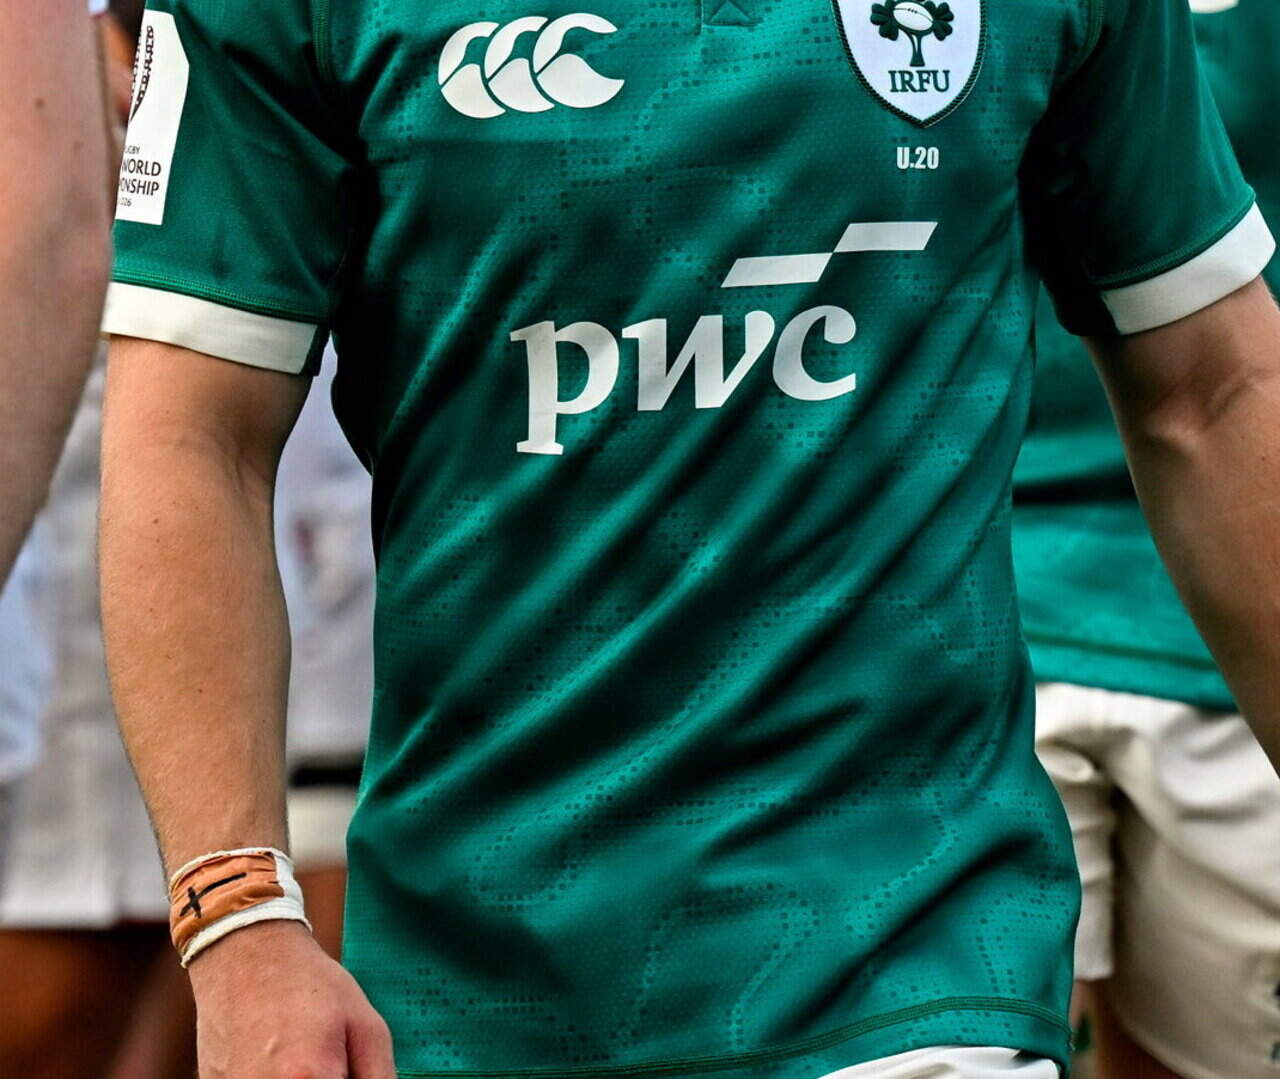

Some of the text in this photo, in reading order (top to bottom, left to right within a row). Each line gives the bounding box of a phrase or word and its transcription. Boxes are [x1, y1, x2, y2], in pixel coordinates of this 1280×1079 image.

[887, 69, 951, 94] IRFU
[895, 146, 940, 170] U.20
[510, 305, 857, 455] pwc
